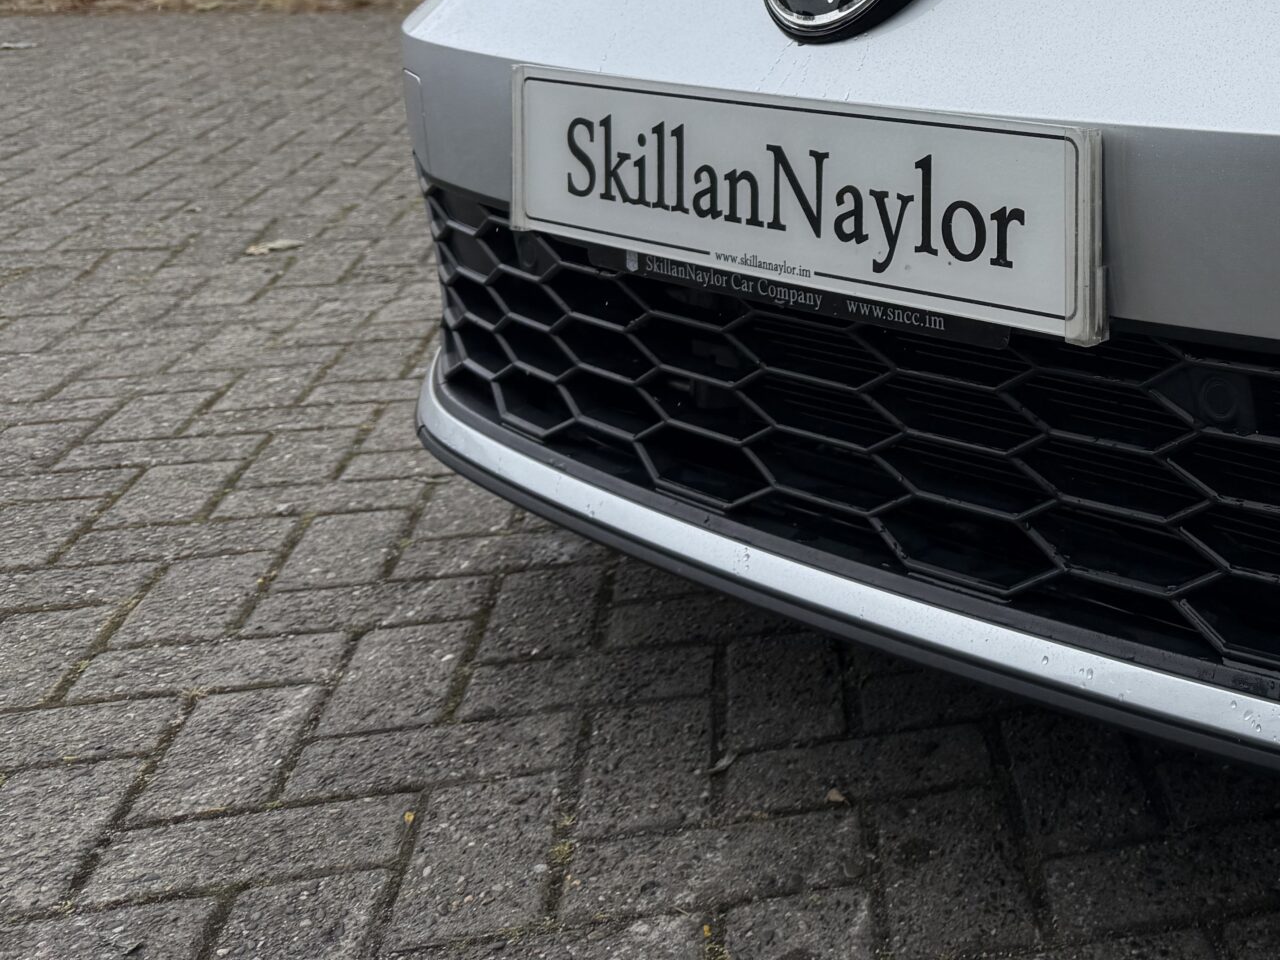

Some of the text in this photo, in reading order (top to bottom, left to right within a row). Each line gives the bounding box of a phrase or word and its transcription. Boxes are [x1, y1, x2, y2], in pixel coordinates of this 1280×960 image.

[566, 114, 1025, 274] SkillanNaylor
[645, 255, 945, 330] SkillanNaylor Car Company www.sncc.im
[715, 251, 811, 278] www.skillannaylor.im
